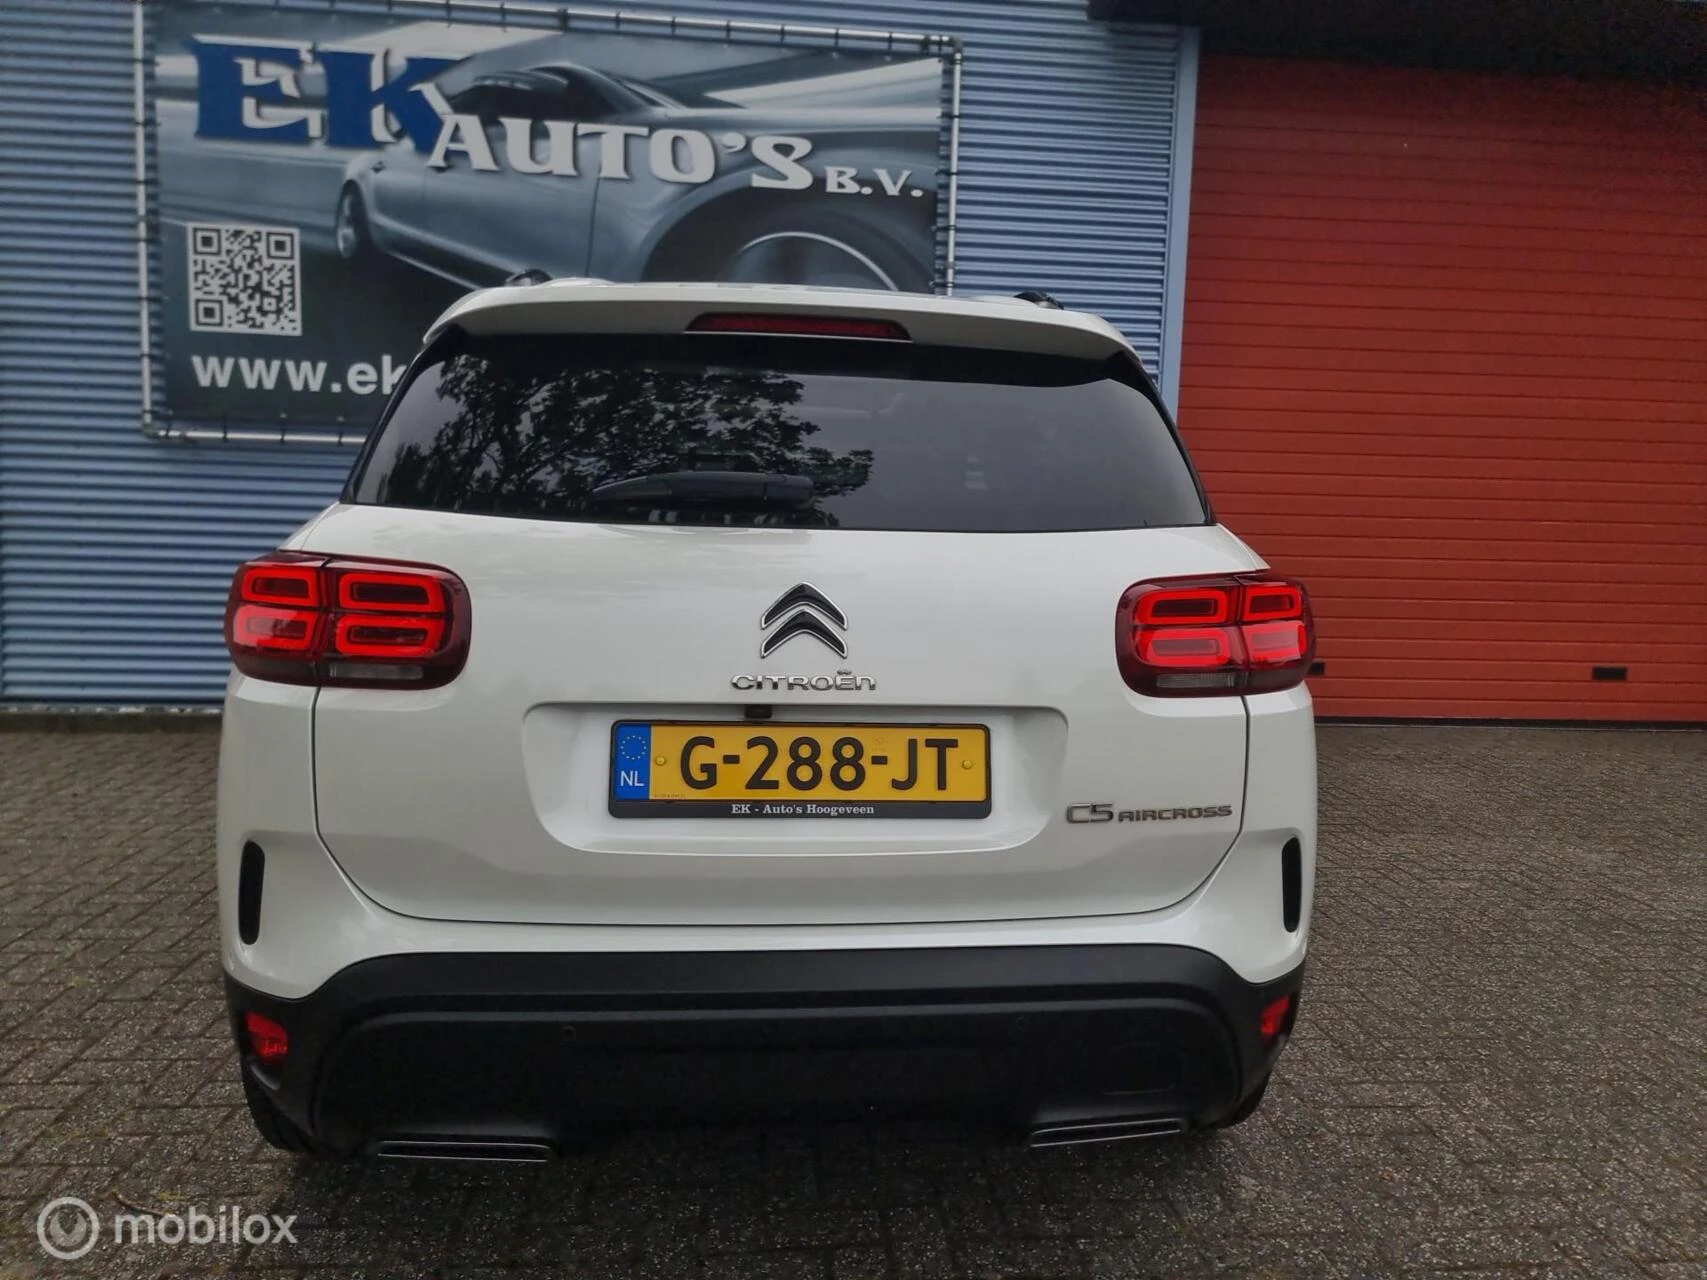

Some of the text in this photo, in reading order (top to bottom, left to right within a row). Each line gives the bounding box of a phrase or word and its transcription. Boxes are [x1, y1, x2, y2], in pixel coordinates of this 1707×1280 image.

[192, 34, 925, 198] EK AUTO'S B.V.
[680, 735, 959, 792] G-288-JT
[620, 770, 645, 787] NL
[731, 804, 751, 814] EK
[762, 804, 803, 814] Auto's
[806, 804, 875, 817] Hoogeveen
[1066, 803, 1233, 824] C5 AIRCROSS
